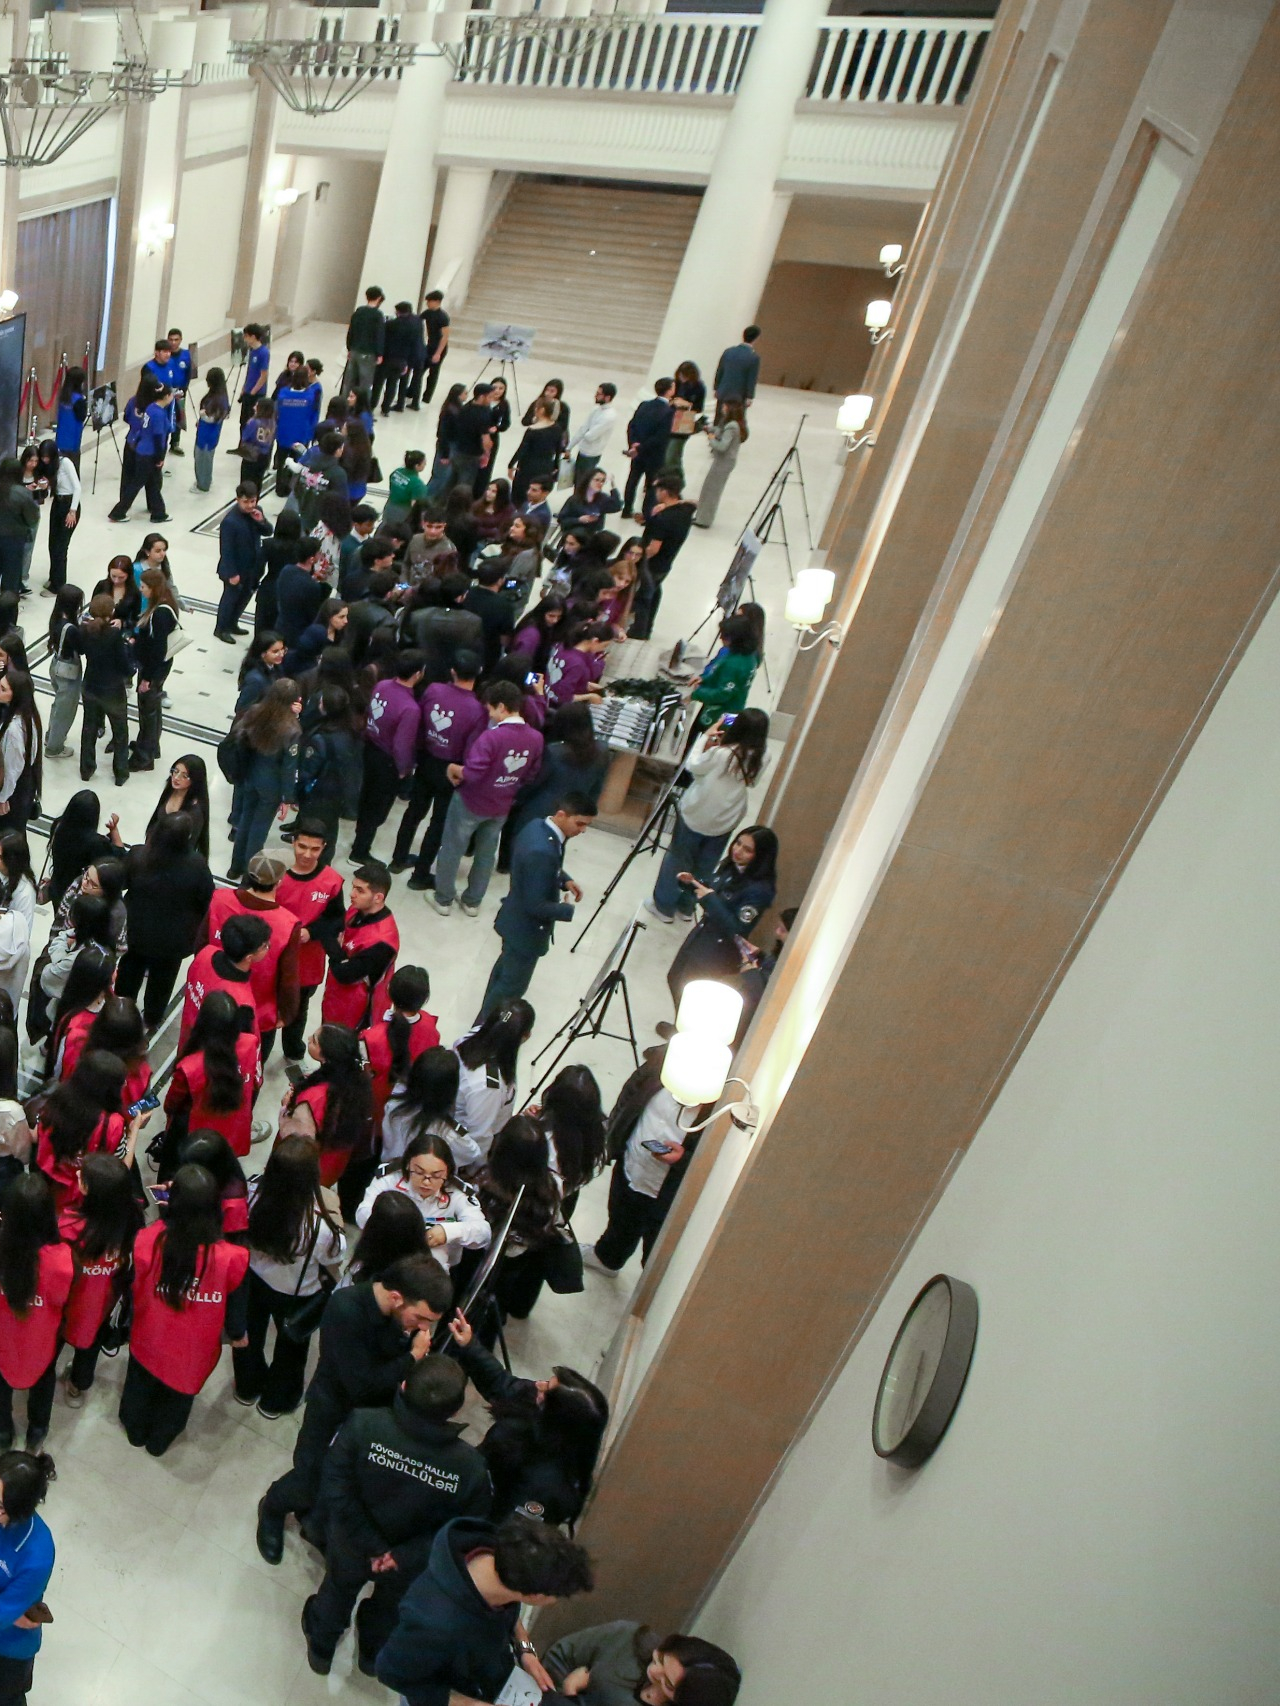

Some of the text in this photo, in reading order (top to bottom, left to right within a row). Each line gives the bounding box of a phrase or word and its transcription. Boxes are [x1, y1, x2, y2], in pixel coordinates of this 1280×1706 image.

[367, 1452, 459, 1494] KÖNÜLLÜLƏRİ
[370, 1442, 460, 1482] FÖVQƏLADƏ HALLAR
